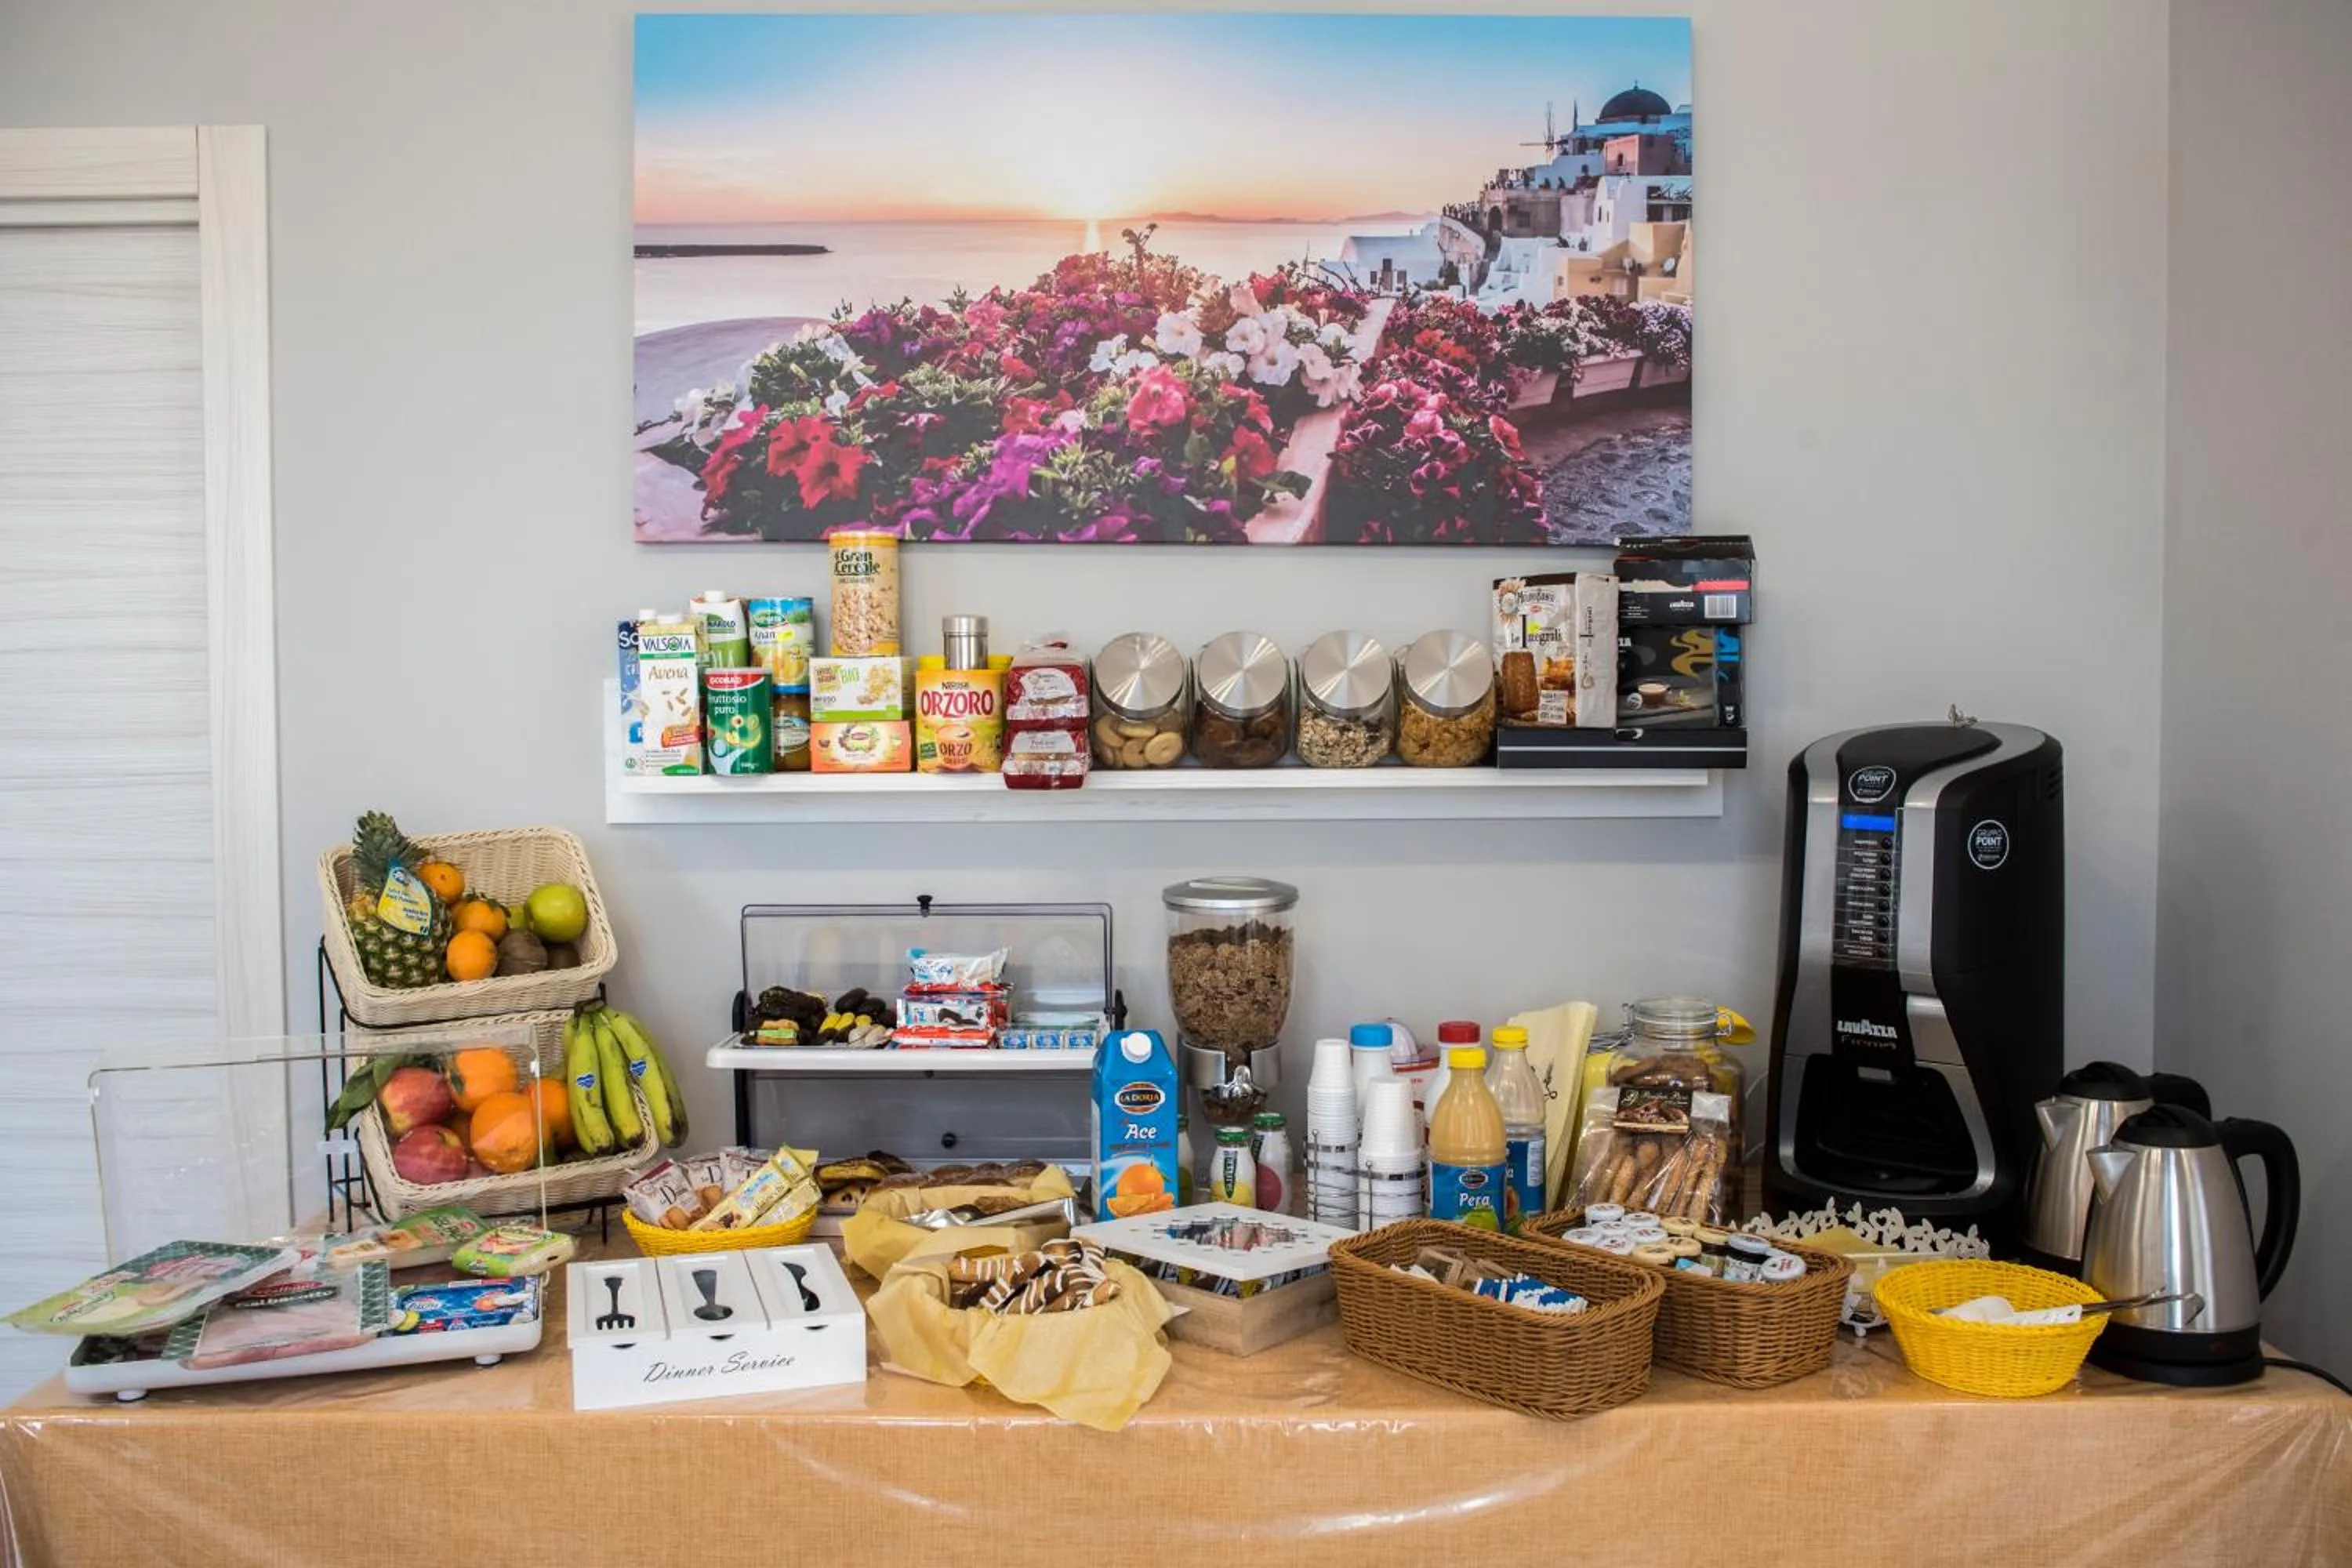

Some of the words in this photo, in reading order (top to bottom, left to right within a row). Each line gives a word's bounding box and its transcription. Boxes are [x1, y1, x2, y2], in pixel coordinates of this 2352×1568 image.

[642, 636, 691, 652] VALSOIA
[648, 666, 689, 680] Avena
[920, 689, 994, 719] ORZORO
[939, 742, 973, 757] ORZO
[1975, 836, 2003, 847] POINT
[1836, 1018, 1898, 1040] LAVAZZA
[1123, 1123, 1157, 1141] Ace
[1459, 1192, 1491, 1208] Pera
[643, 1361, 713, 1383] Dinner
[720, 1350, 796, 1374] Service
